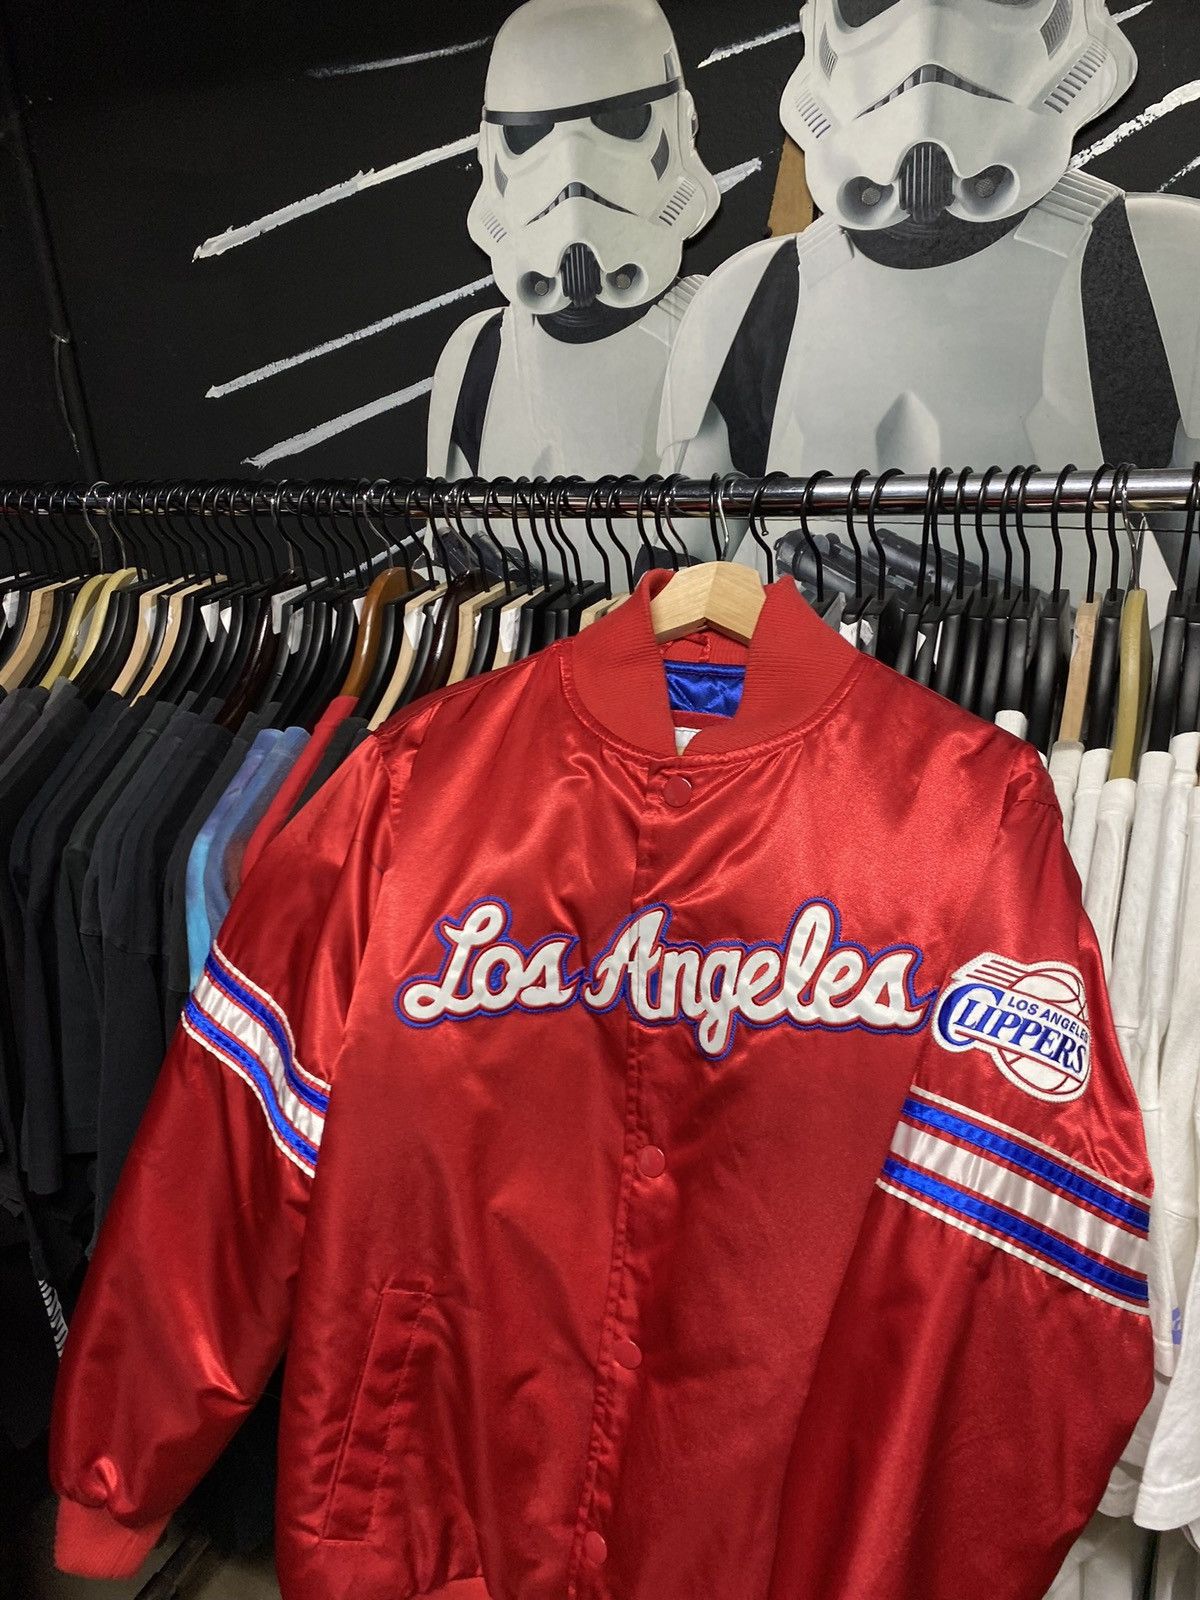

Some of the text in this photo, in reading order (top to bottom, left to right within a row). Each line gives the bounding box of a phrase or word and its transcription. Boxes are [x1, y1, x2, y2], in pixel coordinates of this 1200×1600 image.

[399, 899, 932, 1059] Los Angeles
[1007, 996, 1039, 1016] LOS
[937, 983, 1087, 1074] CLIPPERS
